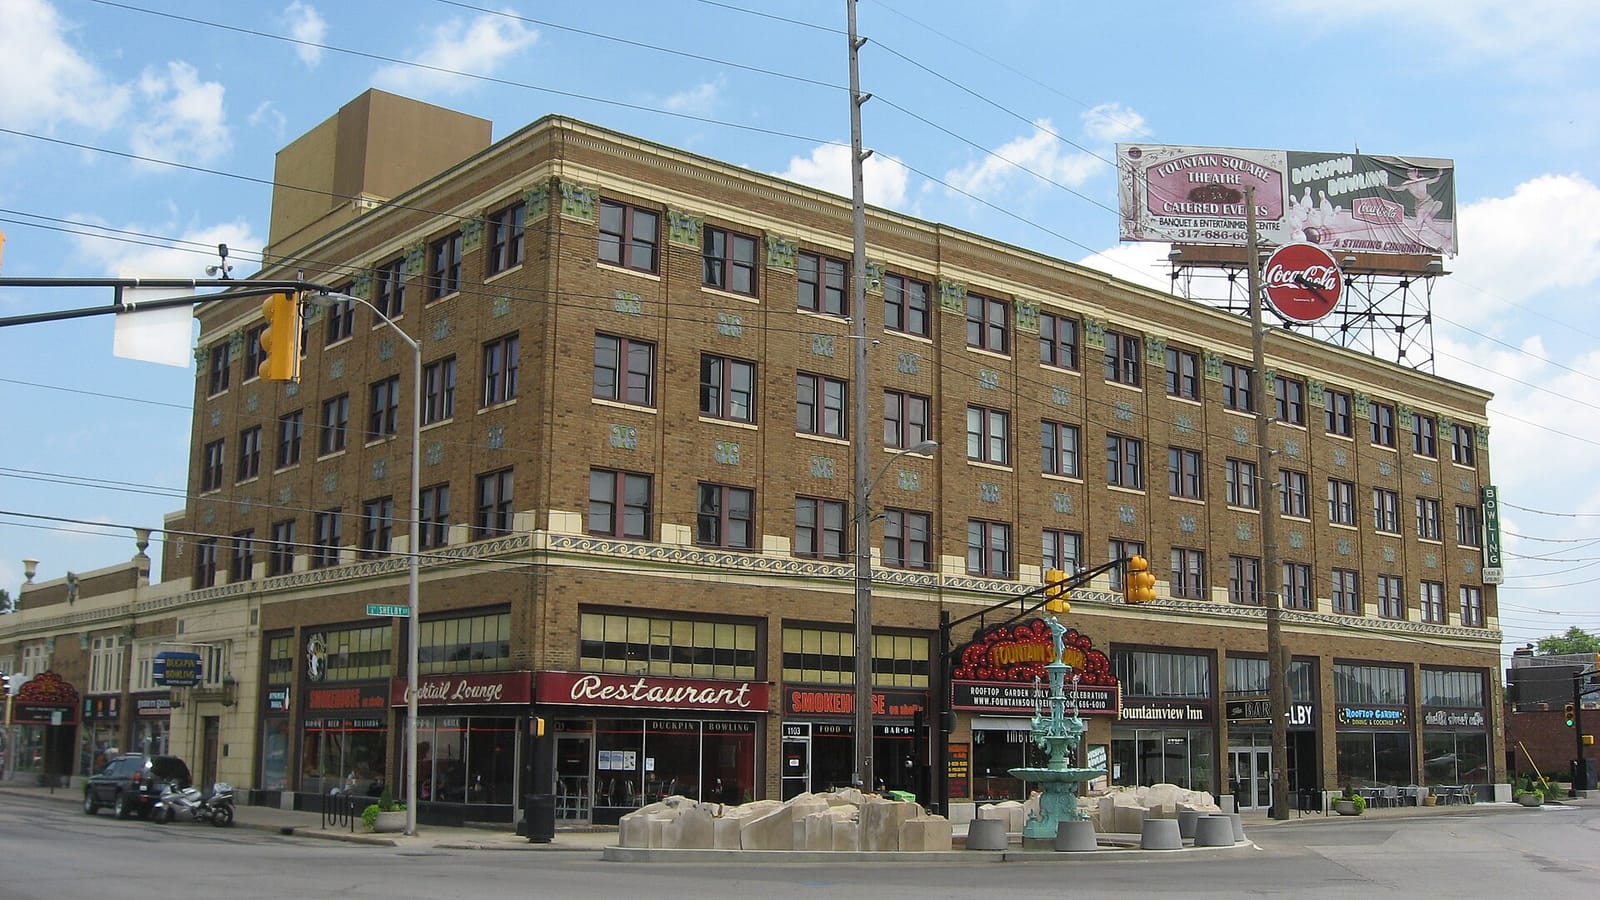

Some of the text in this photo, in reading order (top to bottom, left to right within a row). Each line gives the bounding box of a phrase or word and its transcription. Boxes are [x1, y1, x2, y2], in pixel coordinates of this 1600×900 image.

[1157, 155, 1271, 183] FOUNTAIN SQUARE
[1292, 156, 1353, 185] DUCKPIN
[1187, 171, 1242, 185] THEATRE
[1327, 170, 1389, 197] BOWLING
[1163, 202, 1268, 216] CATERED EVETS
[1357, 200, 1397, 218] Coca-Cola
[1159, 217, 1280, 231] BANQUET & ENTERTAINMEN CENTRE
[1178, 229, 1261, 241] 317-686-600
[1342, 239, 1382, 250] STRIKING
[1267, 264, 1337, 290] Coca-Cola
[1486, 489, 1498, 564] BOWLING
[379, 606, 403, 615] SHELBY
[993, 643, 1044, 666] FOUNTAIN
[403, 681, 451, 703] Ccktail
[451, 680, 503, 702] Lounge
[571, 675, 751, 708] Restaurant
[970, 686, 999, 697] ROOFTOP
[1004, 688, 1029, 698] GARDEN
[1069, 691, 1108, 700] CELEBRATION
[791, 691, 885, 715] SMOKEHSE
[1079, 699, 1106, 709] 686-6010
[1120, 703, 1203, 720] ountainview Inn
[1244, 701, 1272, 718] BAR
[652, 720, 749, 732] DUCKPIN BOWLING
[787, 726, 801, 736] 1103
[819, 725, 841, 733] FOOD
